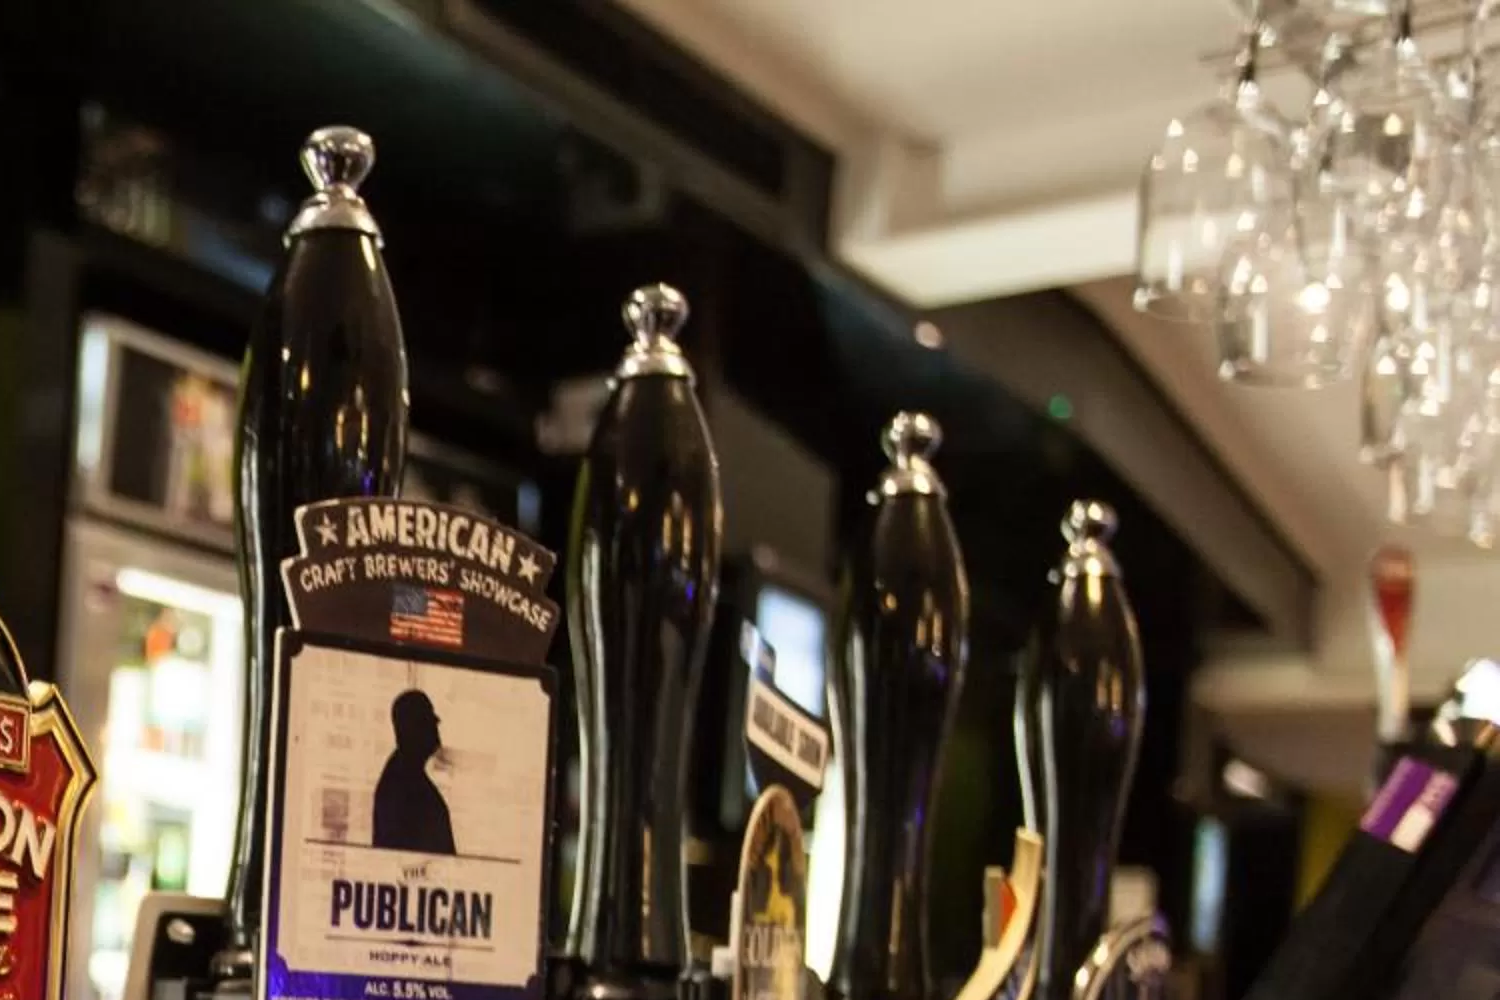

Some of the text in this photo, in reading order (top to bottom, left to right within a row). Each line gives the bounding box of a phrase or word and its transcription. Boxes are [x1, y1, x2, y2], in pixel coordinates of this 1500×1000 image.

[346, 502, 516, 575] AMERICAN
[300, 556, 356, 592] CRAFT
[459, 568, 552, 633] SHOWCASE
[330, 879, 493, 939] PUBLICAN
[369, 950, 452, 968] HOPPY ALE
